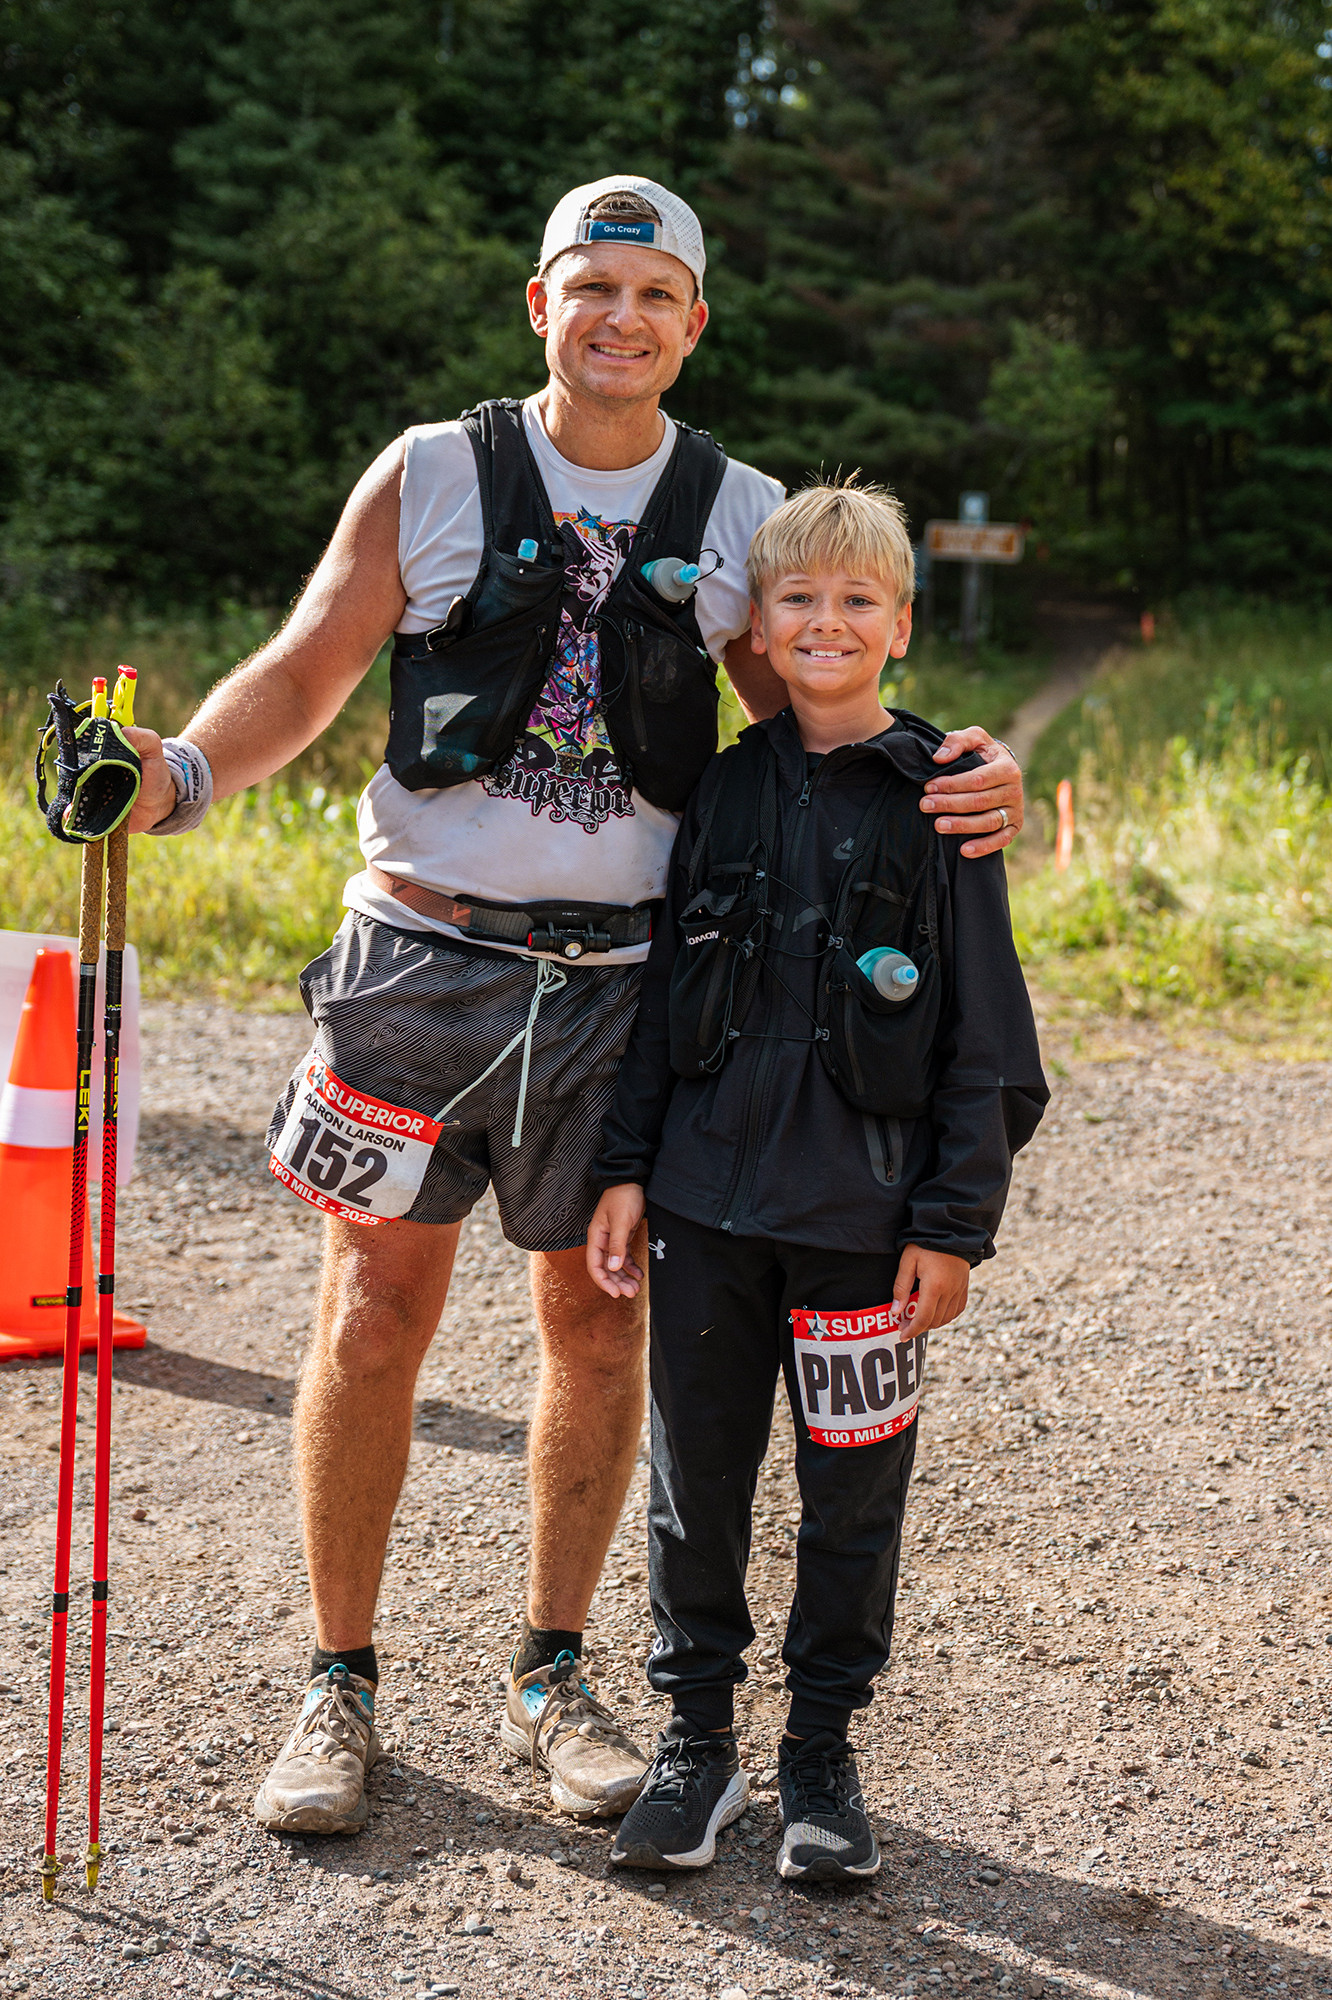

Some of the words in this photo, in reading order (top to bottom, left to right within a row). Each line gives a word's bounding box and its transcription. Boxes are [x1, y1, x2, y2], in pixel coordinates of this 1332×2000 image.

[603, 225, 615, 233] Go
[617, 226, 641, 235] Crazy
[91, 724, 107, 754] LEKI
[686, 930, 720, 946] OMON
[78, 1069, 92, 1131] LEKI
[325, 1082, 425, 1136] SUPERIOR
[303, 1092, 344, 1131] AARON
[344, 1124, 406, 1153] LARSON
[289, 1117, 388, 1209] 152
[291, 1177, 328, 1210] MILE
[337, 1205, 380, 1226] 2025
[831, 1301, 918, 1337] SUPERIO
[821, 1431, 850, 1444] 100
[855, 1422, 894, 1443] MILE
